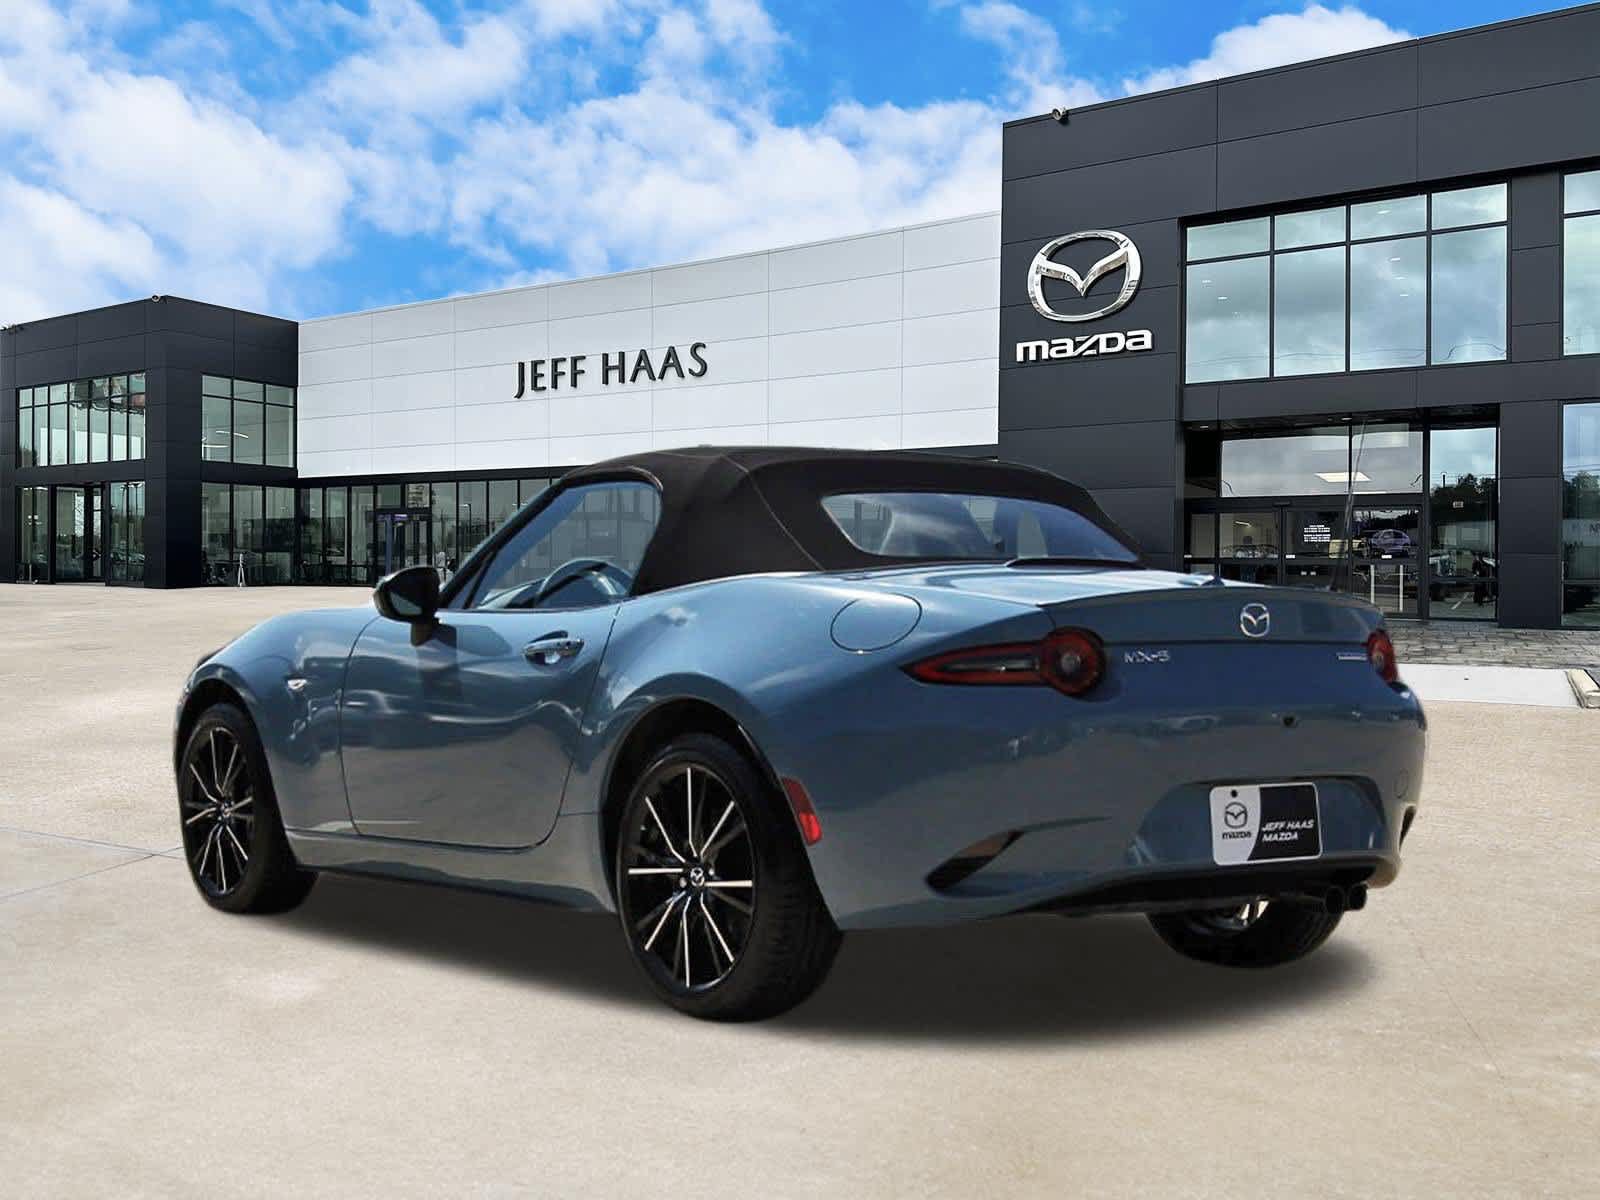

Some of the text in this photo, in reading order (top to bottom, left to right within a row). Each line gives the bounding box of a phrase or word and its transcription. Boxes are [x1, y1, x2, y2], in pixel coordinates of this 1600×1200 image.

[1016, 329, 1153, 362] mazda
[514, 342, 708, 399] JEFF HAAS
[1262, 819, 1315, 831] JEFF HAAS
[1222, 831, 1252, 840] mazda
[1262, 832, 1299, 842] MAZDA
